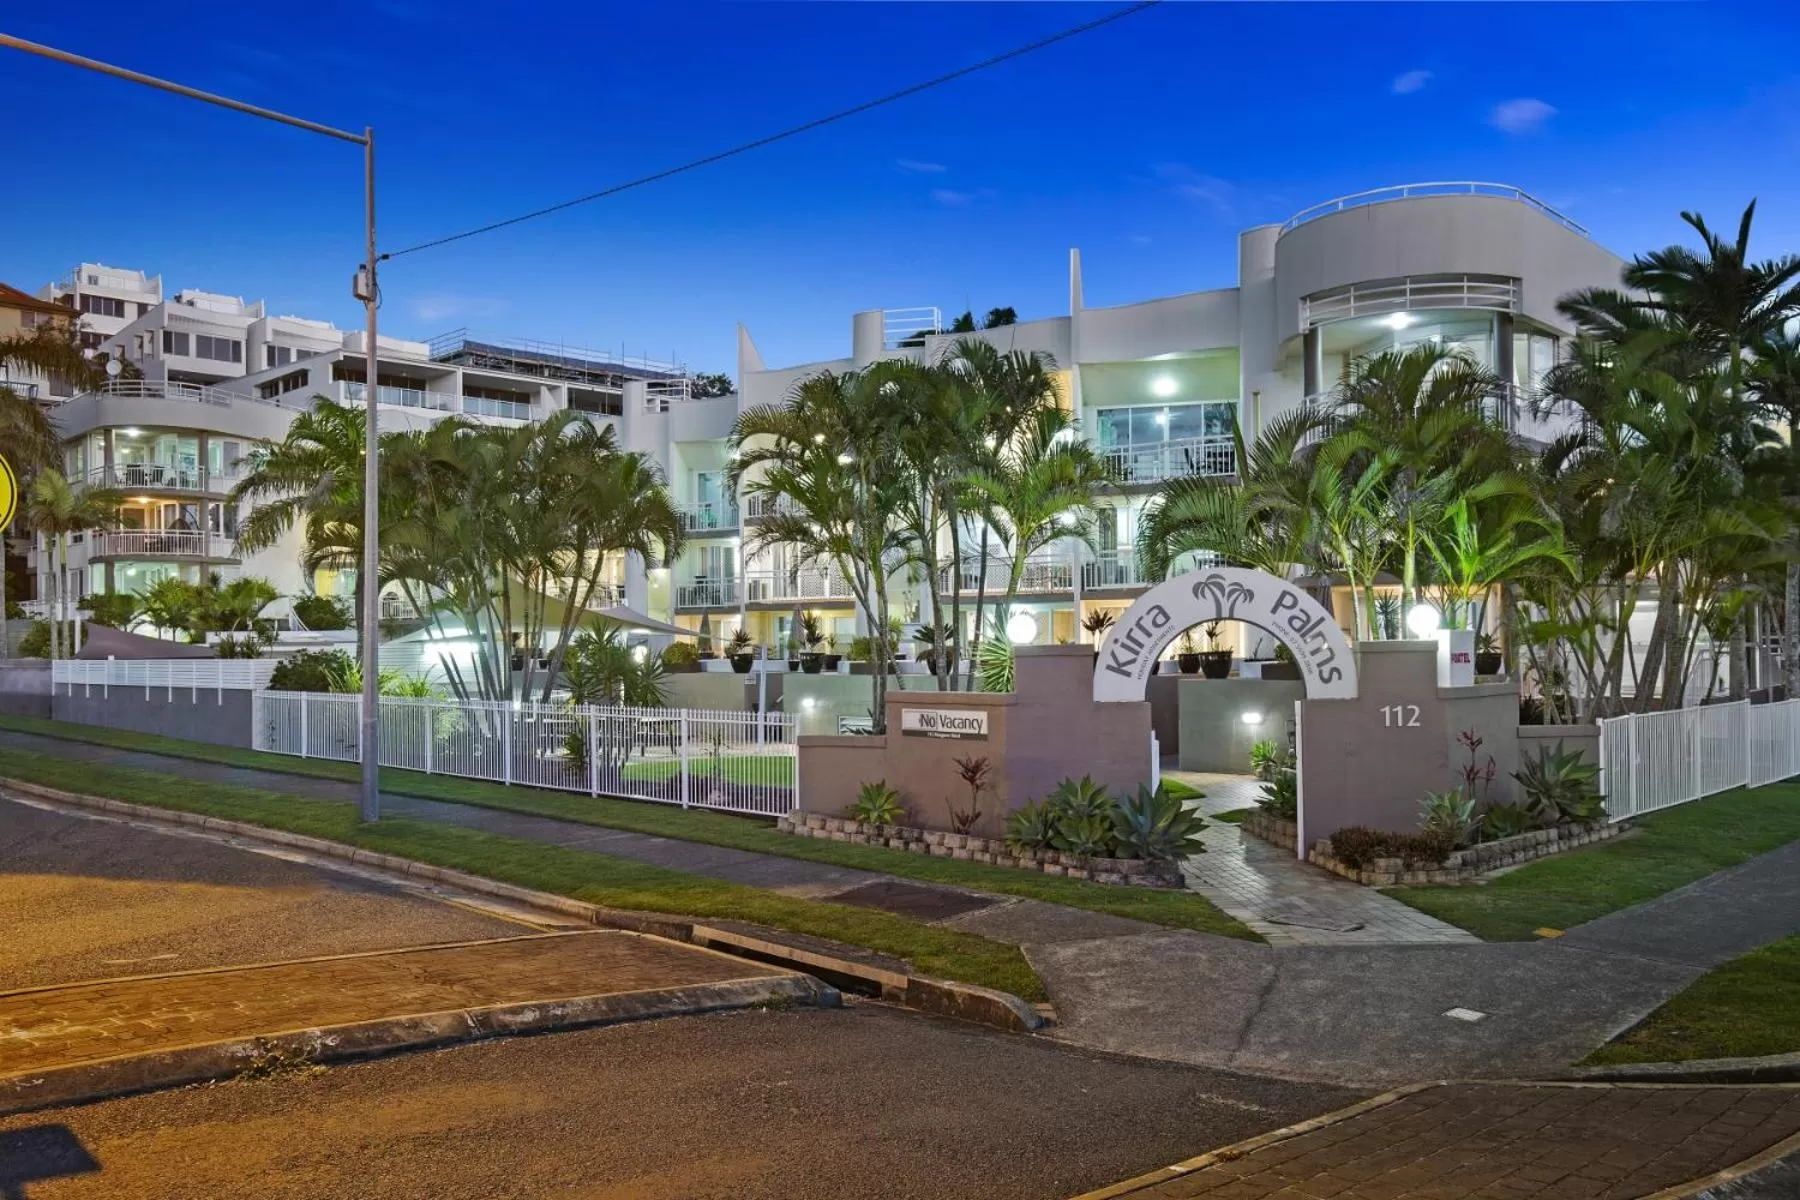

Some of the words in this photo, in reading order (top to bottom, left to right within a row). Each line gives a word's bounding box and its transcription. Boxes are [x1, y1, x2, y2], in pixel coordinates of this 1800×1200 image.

[1106, 604, 1171, 678] Kirra
[1270, 590, 1342, 684] Palms
[919, 713, 936, 728] No
[939, 714, 983, 733] Vacancy
[1380, 704, 1420, 727] 112
